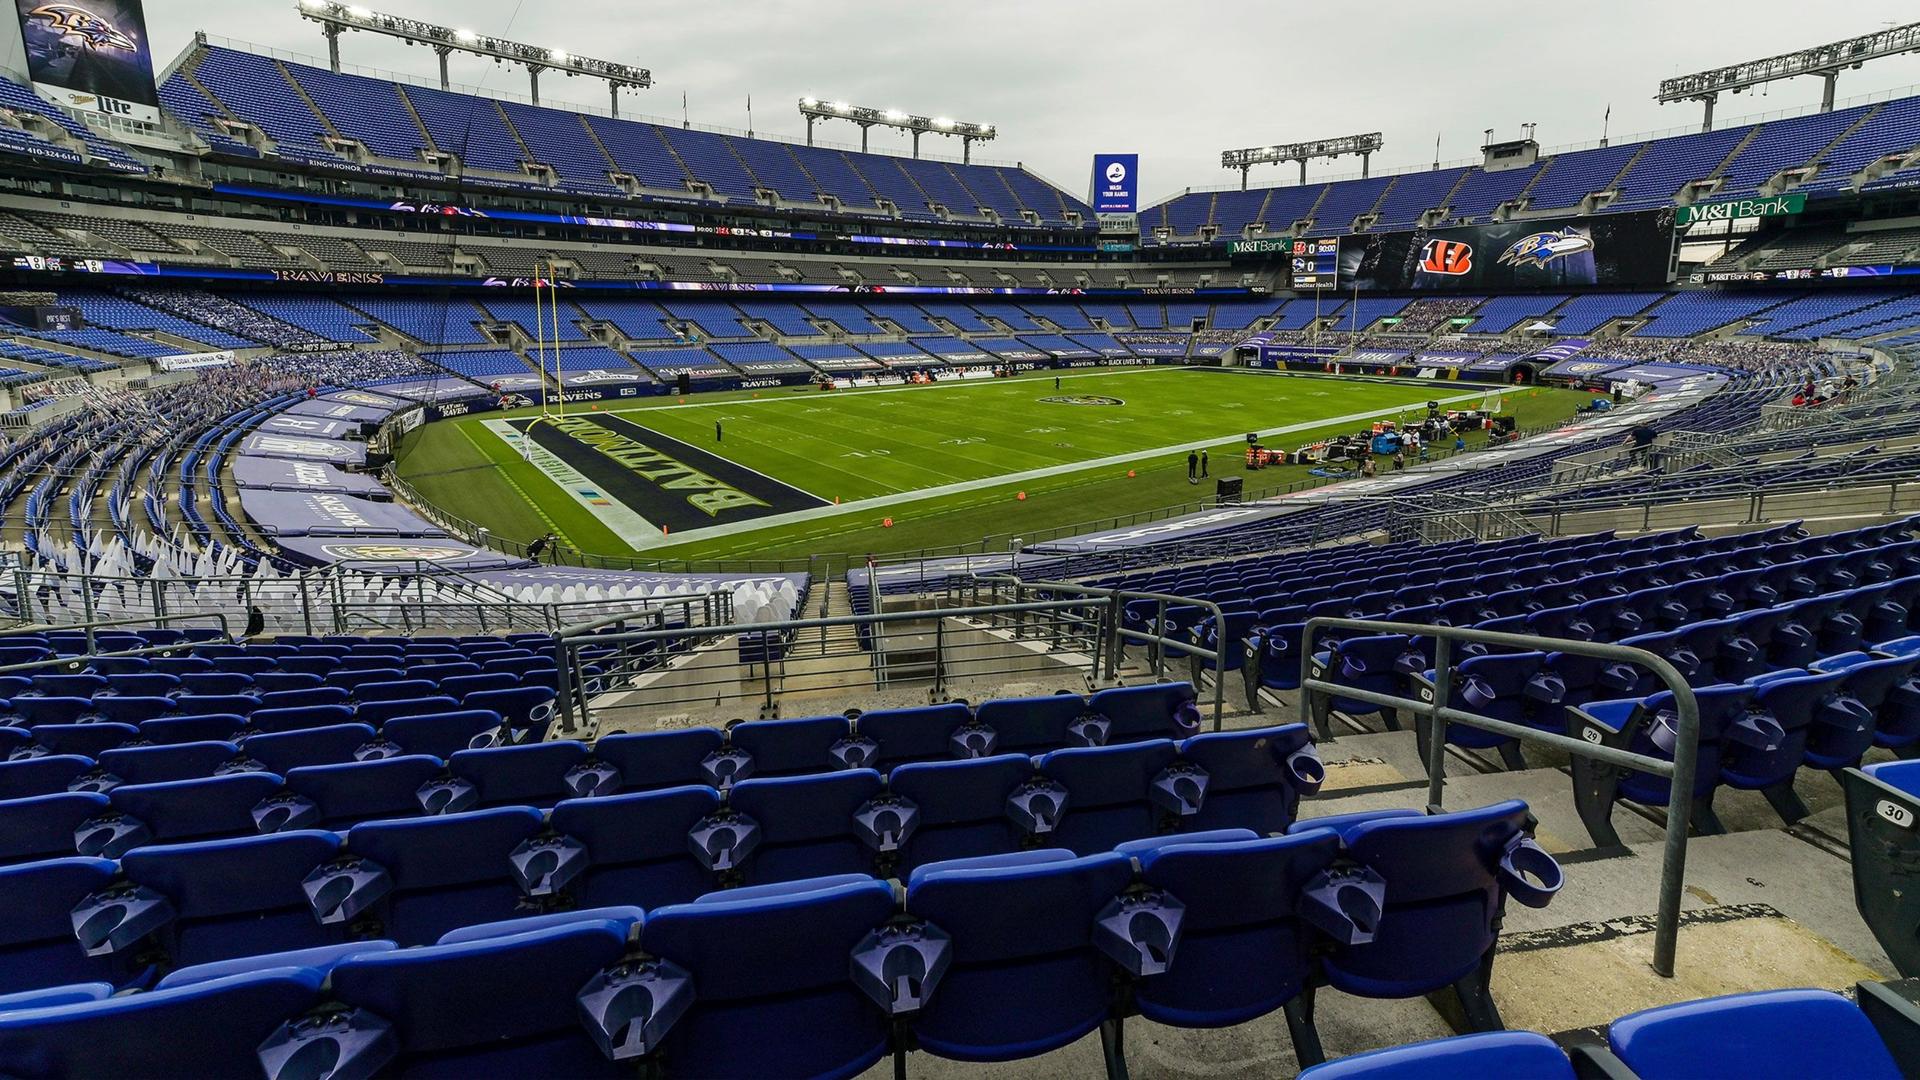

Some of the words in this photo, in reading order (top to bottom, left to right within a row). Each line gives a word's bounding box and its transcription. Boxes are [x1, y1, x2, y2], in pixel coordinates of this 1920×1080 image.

[96, 94, 132, 115] Lite
[28, 147, 81, 161] 410-324-6141
[109, 162, 145, 172] RAVENS
[309, 159, 327, 167] RING
[333, 163, 362, 172] HONOR
[1688, 201, 1738, 221] M&T
[1738, 197, 1790, 217] Bank
[1233, 241, 1261, 252] M&T
[1261, 240, 1286, 251] Bank
[1308, 243, 1316, 254] 0
[1318, 245, 1336, 253] 90:00
[1307, 261, 1314, 272] 0
[1711, 272, 1730, 280] M&T
[1730, 271, 1750, 280] Bank
[741, 379, 782, 388] RAVENS
[547, 391, 603, 402] RAVENS
[438, 404, 454, 412] PLAY
[443, 406, 469, 416] RAVEN
[312, 495, 371, 528] RAVENS
[1585, 729, 1600, 743] 29
[1886, 806, 1906, 822] 30
